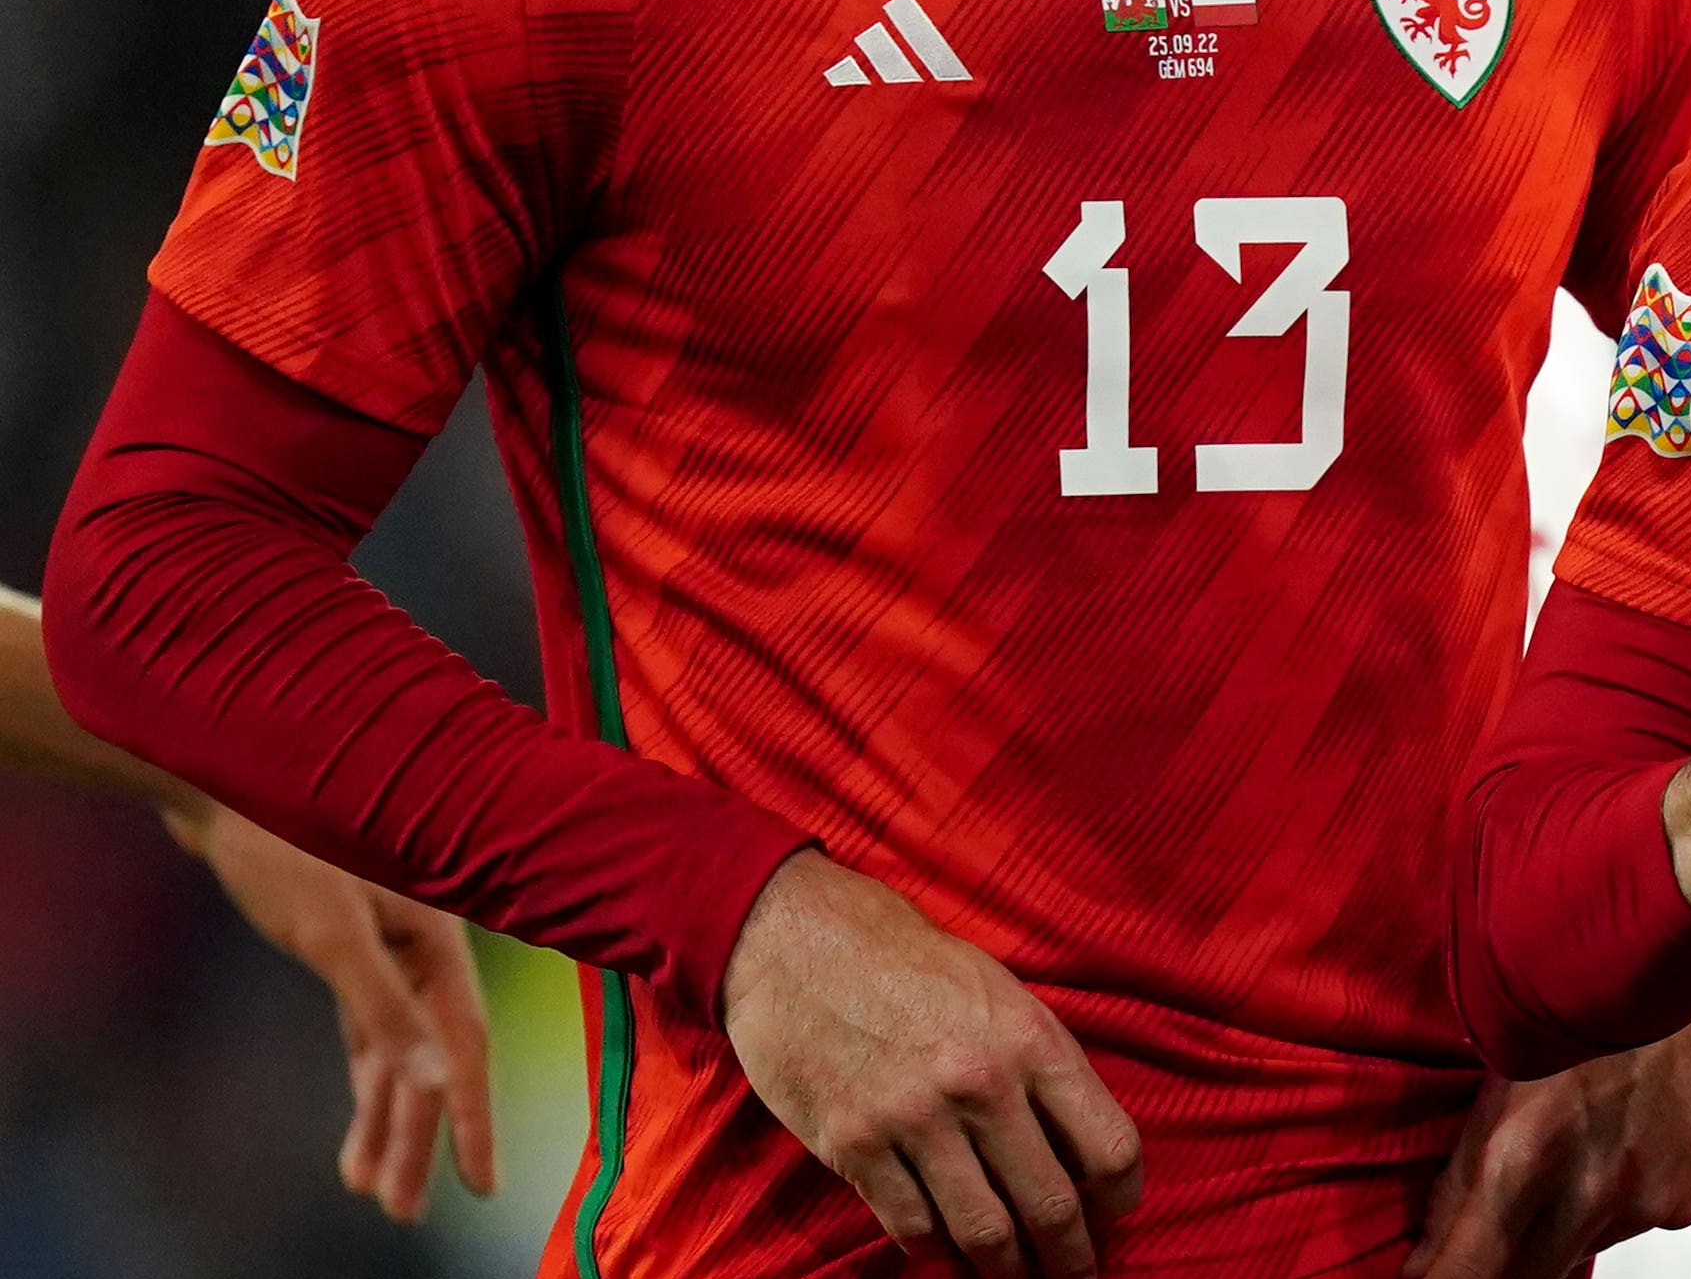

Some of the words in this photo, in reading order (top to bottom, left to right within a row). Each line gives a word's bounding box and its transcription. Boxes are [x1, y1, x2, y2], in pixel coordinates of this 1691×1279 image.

[1148, 33, 1218, 56] 25.09.22
[1188, 56, 1214, 77] 694
[1042, 196, 1350, 497] 13
